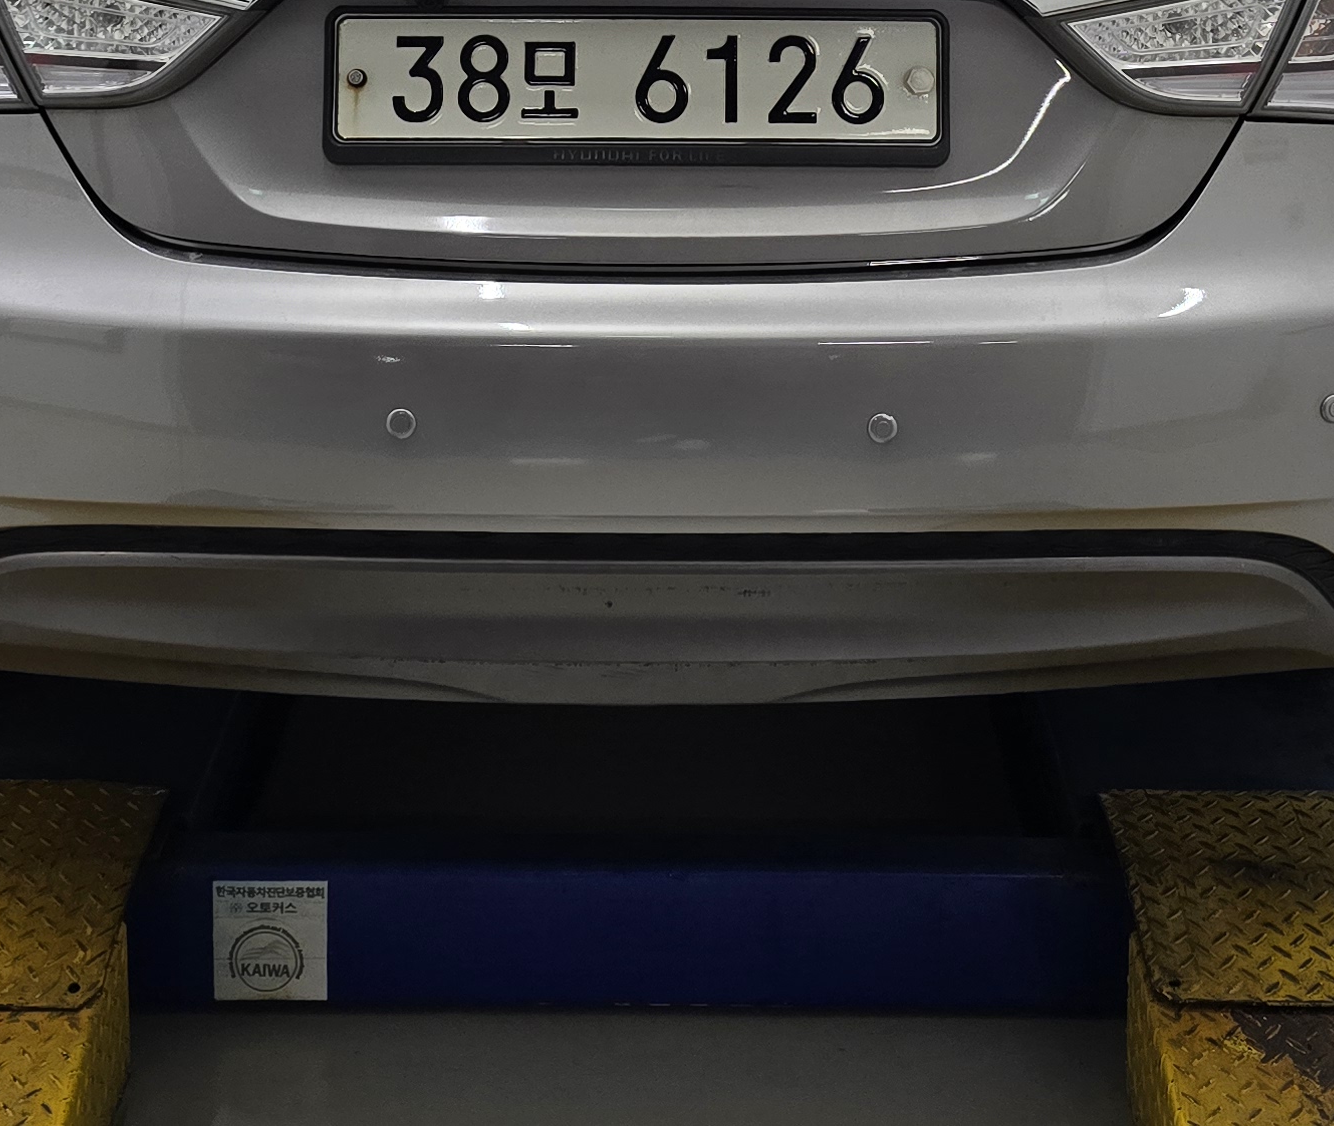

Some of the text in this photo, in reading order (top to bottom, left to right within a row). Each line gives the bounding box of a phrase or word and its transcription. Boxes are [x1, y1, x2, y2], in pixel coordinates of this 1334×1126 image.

[392, 34, 886, 125] 38모 6126
[246, 901, 298, 914] 오토커스
[241, 963, 291, 978] KAIWA
